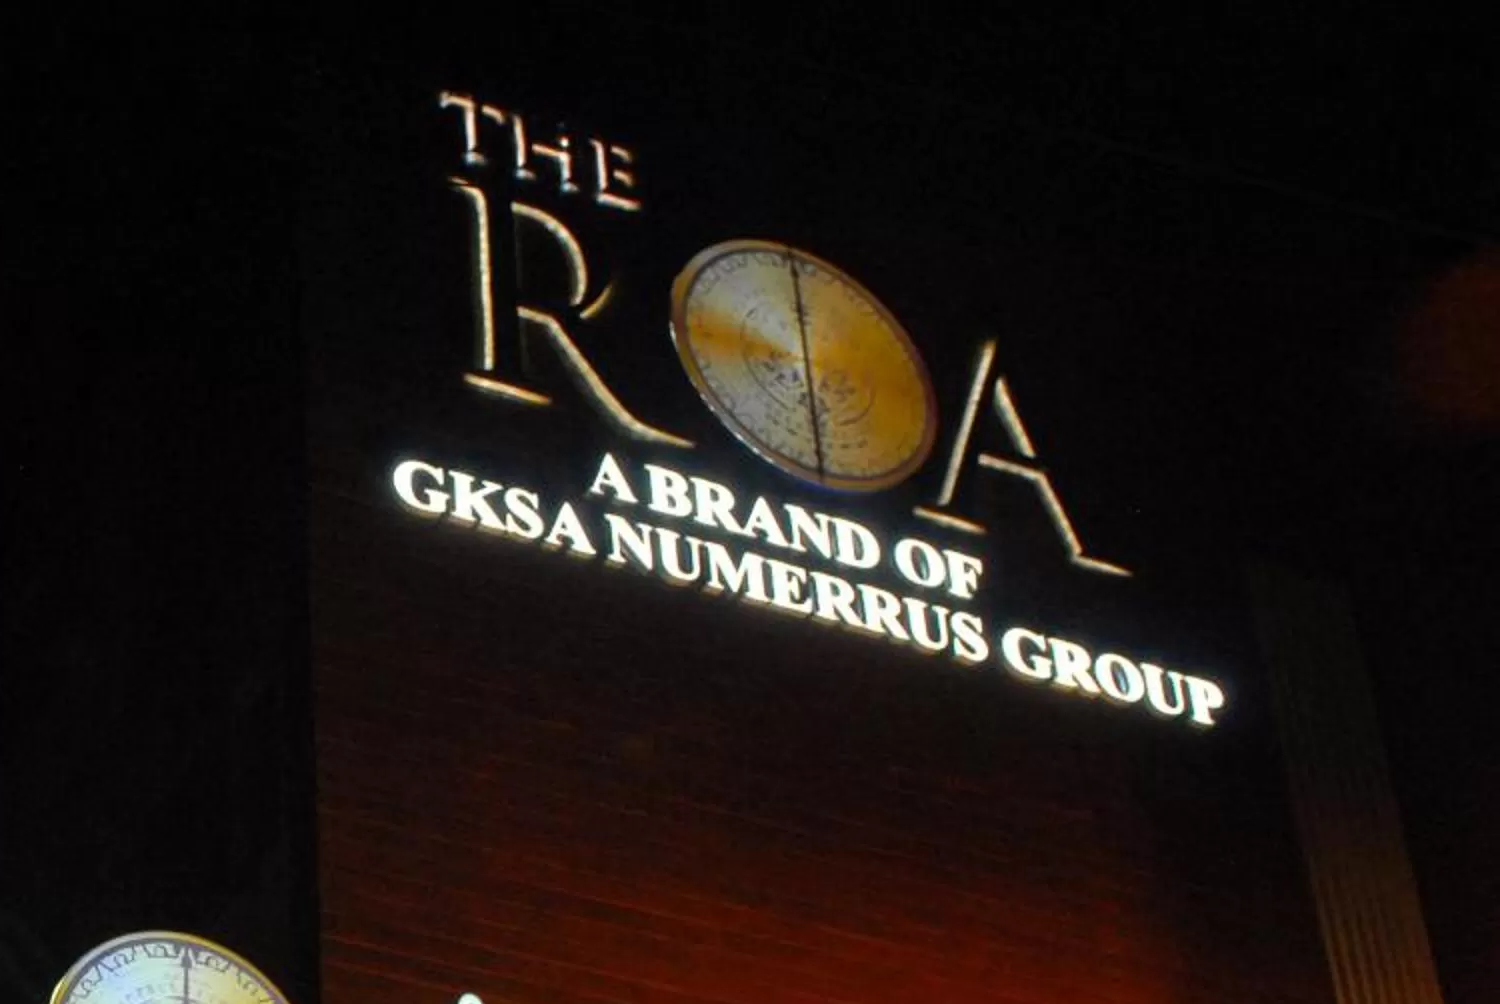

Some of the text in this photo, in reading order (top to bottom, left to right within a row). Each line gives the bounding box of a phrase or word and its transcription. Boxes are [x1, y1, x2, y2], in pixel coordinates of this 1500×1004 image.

[437, 88, 644, 213] THE
[392, 460, 1225, 727] GKSA NUMERRUS GROUP
[590, 452, 984, 600] A BRAND OF
